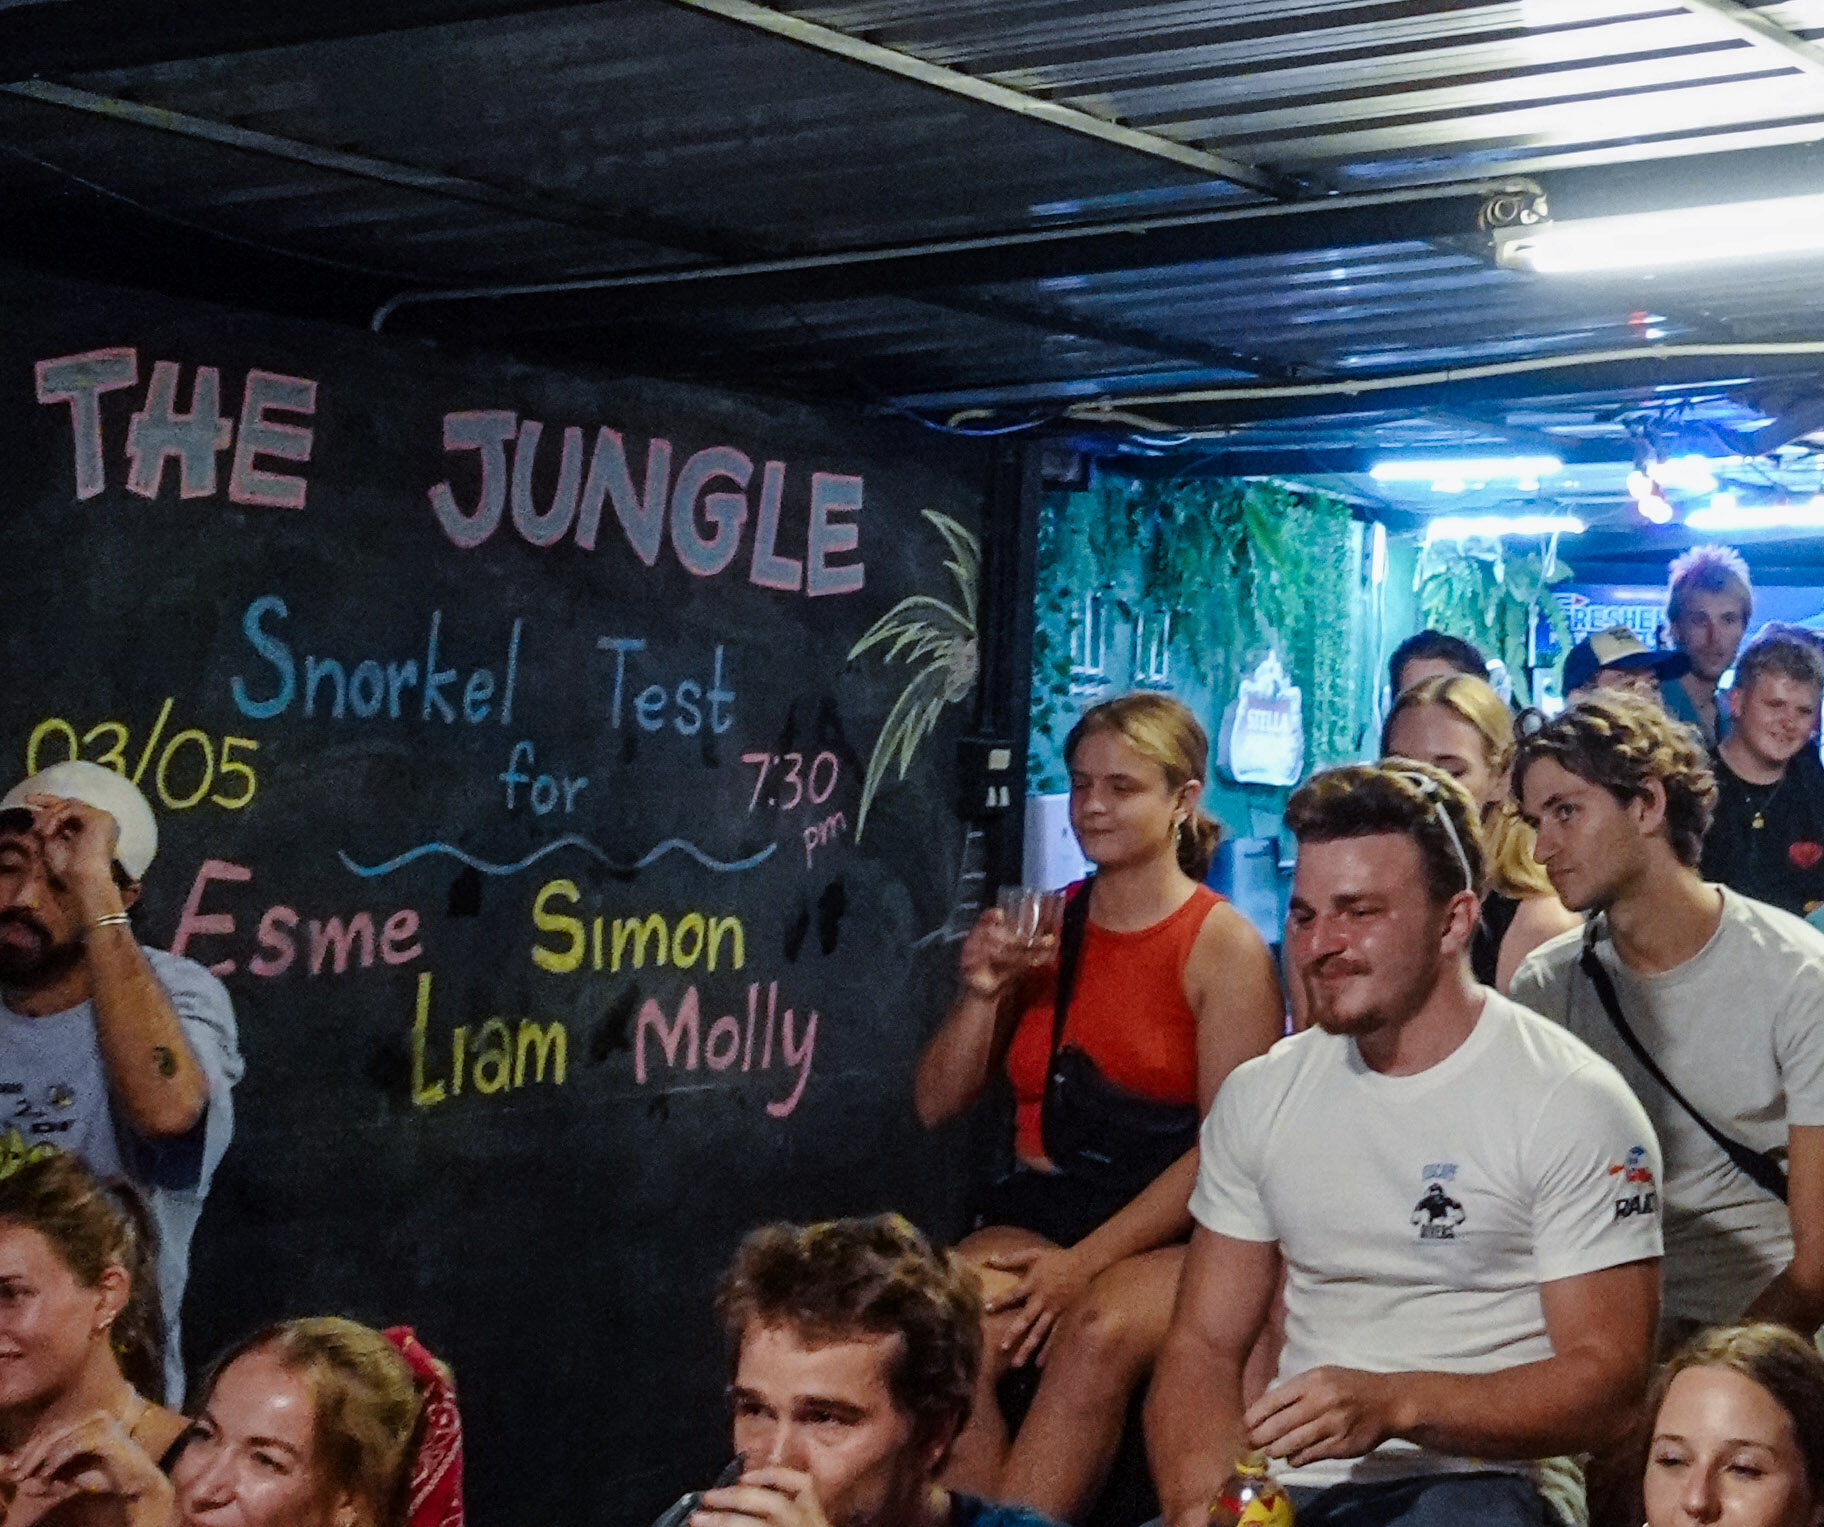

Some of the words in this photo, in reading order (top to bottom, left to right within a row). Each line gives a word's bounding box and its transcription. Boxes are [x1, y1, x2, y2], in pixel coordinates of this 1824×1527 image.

[36, 347, 317, 510] THE
[427, 410, 866, 596] JUNGLE
[231, 597, 522, 726] Snorkel
[597, 637, 737, 736] Test
[499, 739, 590, 817] for
[804, 811, 846, 869] pm
[170, 860, 423, 979] Esme
[531, 878, 746, 974] Simon
[410, 972, 568, 1108] Liam
[633, 983, 820, 1119] Molly
